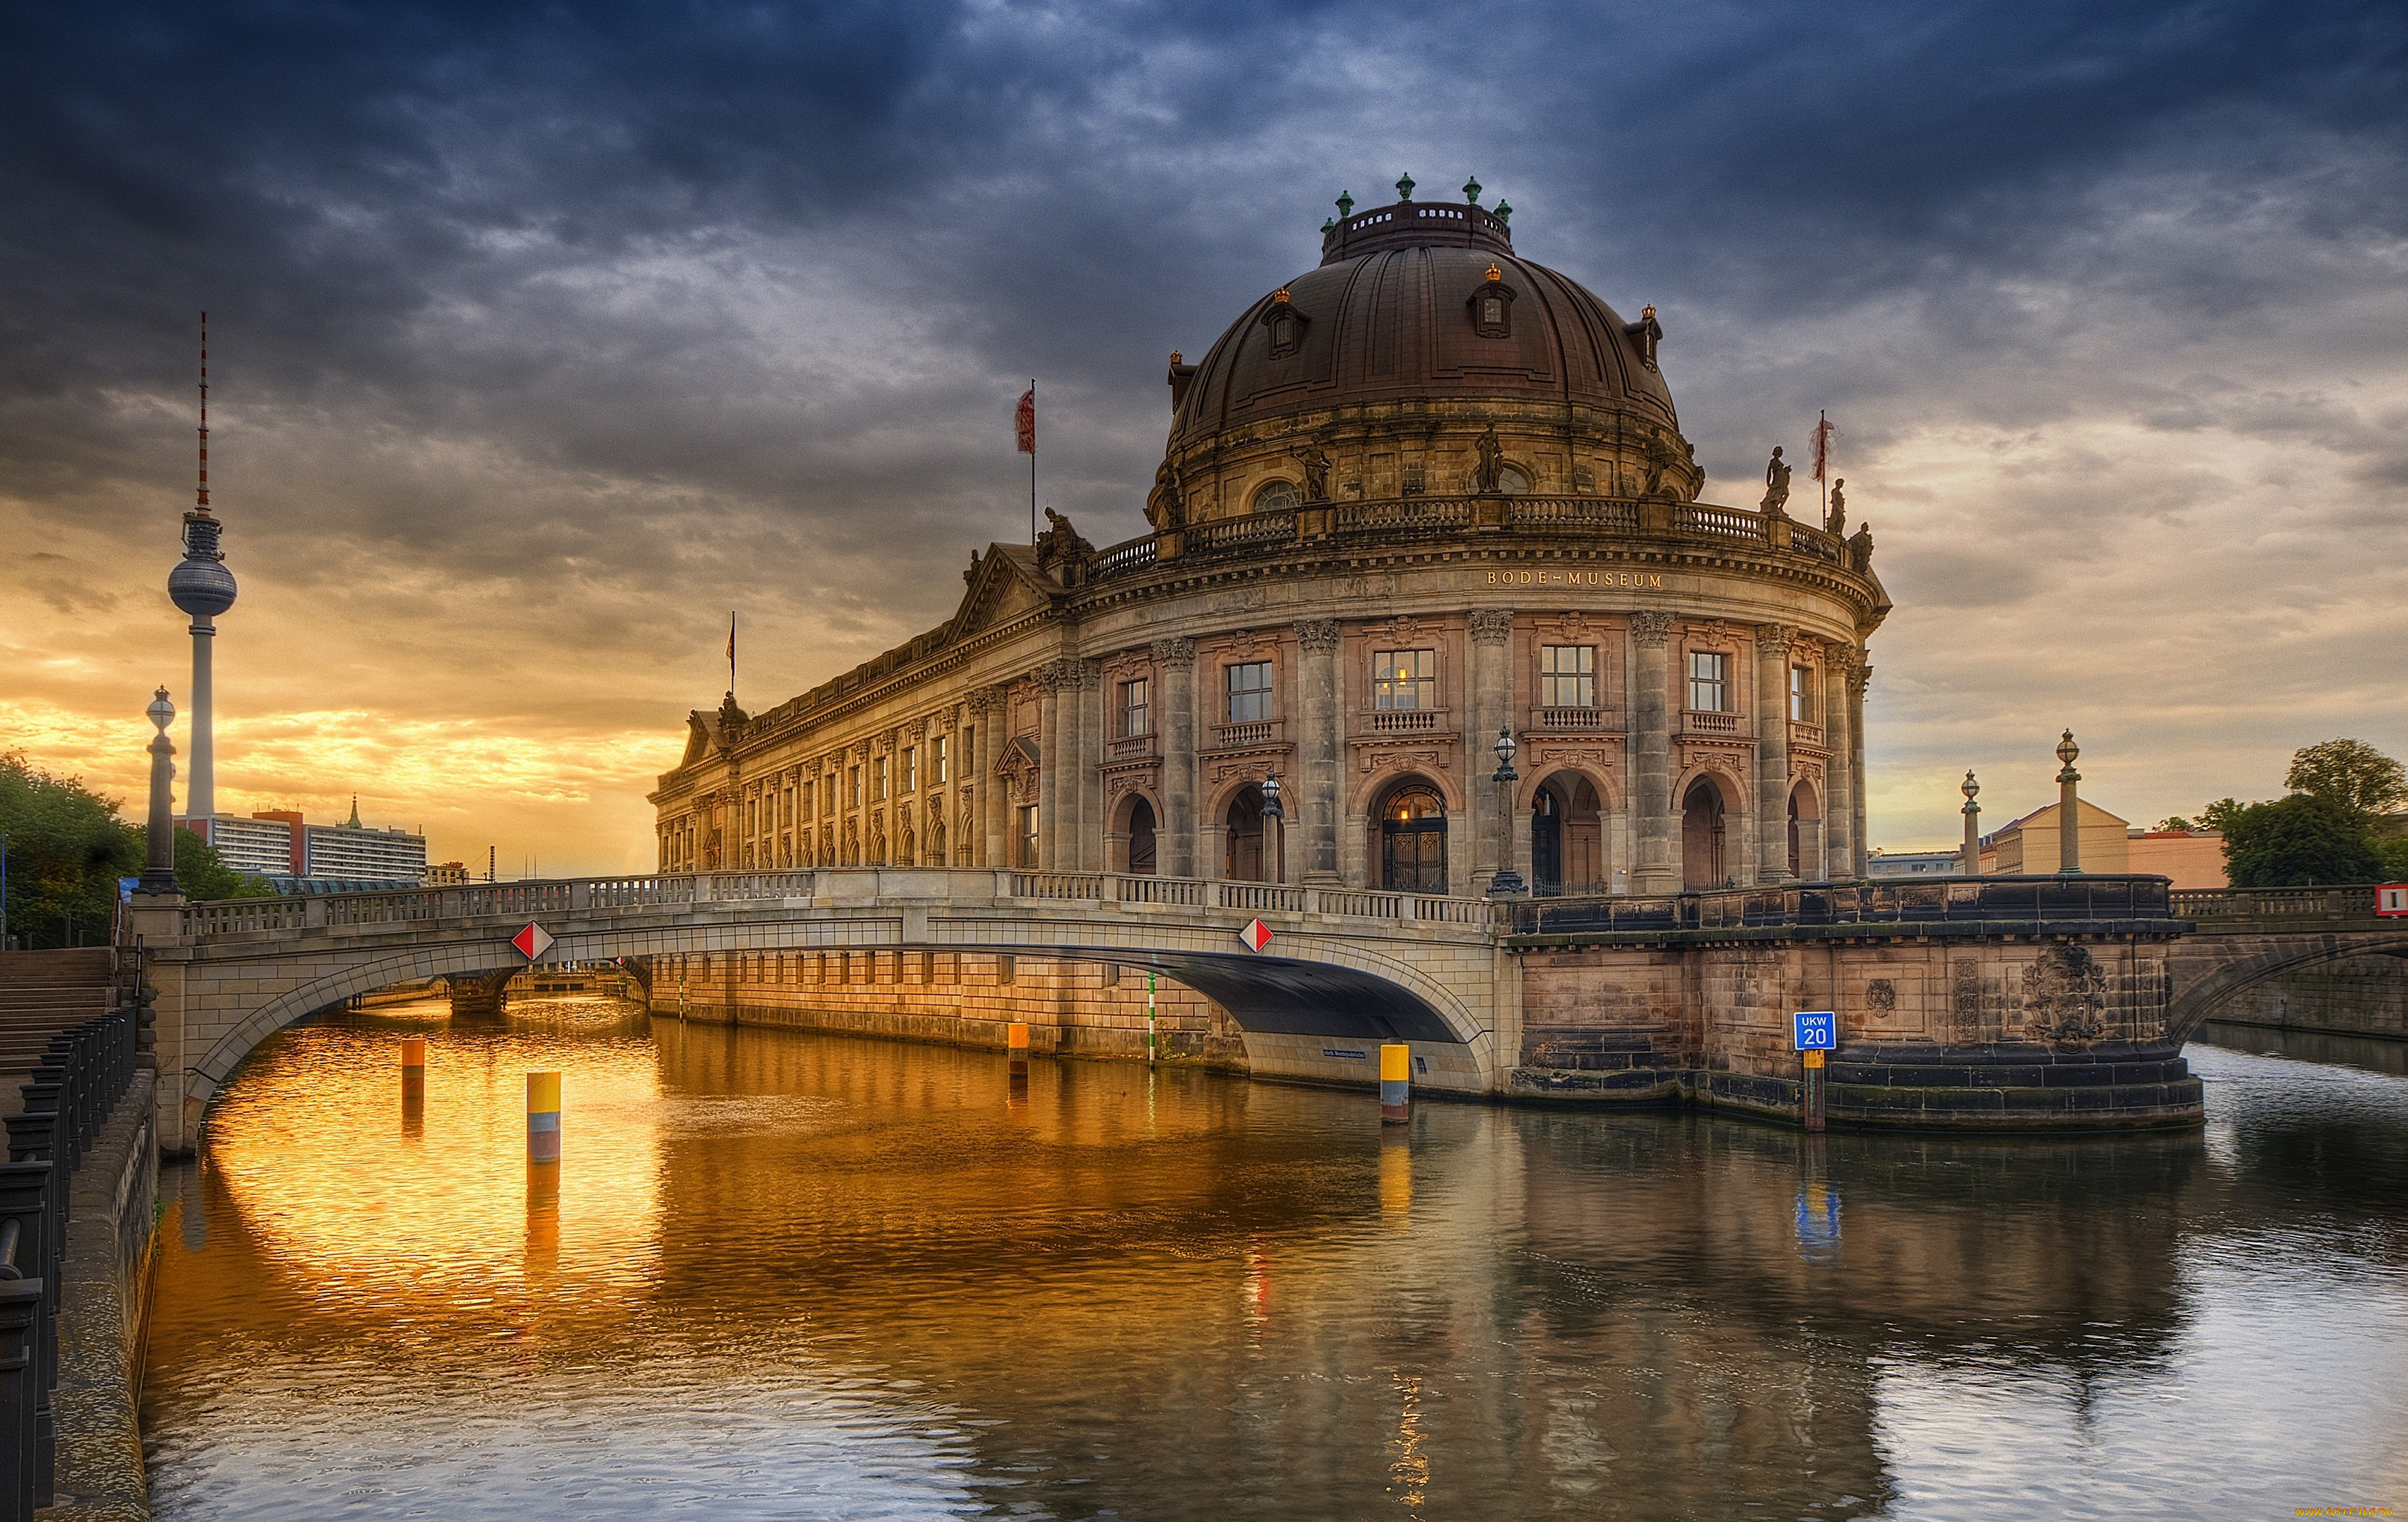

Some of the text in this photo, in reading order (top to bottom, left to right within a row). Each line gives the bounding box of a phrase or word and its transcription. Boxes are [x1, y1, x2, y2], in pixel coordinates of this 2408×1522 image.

[1487, 571, 1661, 588] BODE-MUSEUM
[1802, 1017, 1826, 1026] UKW
[1804, 1028, 1826, 1045] 20
